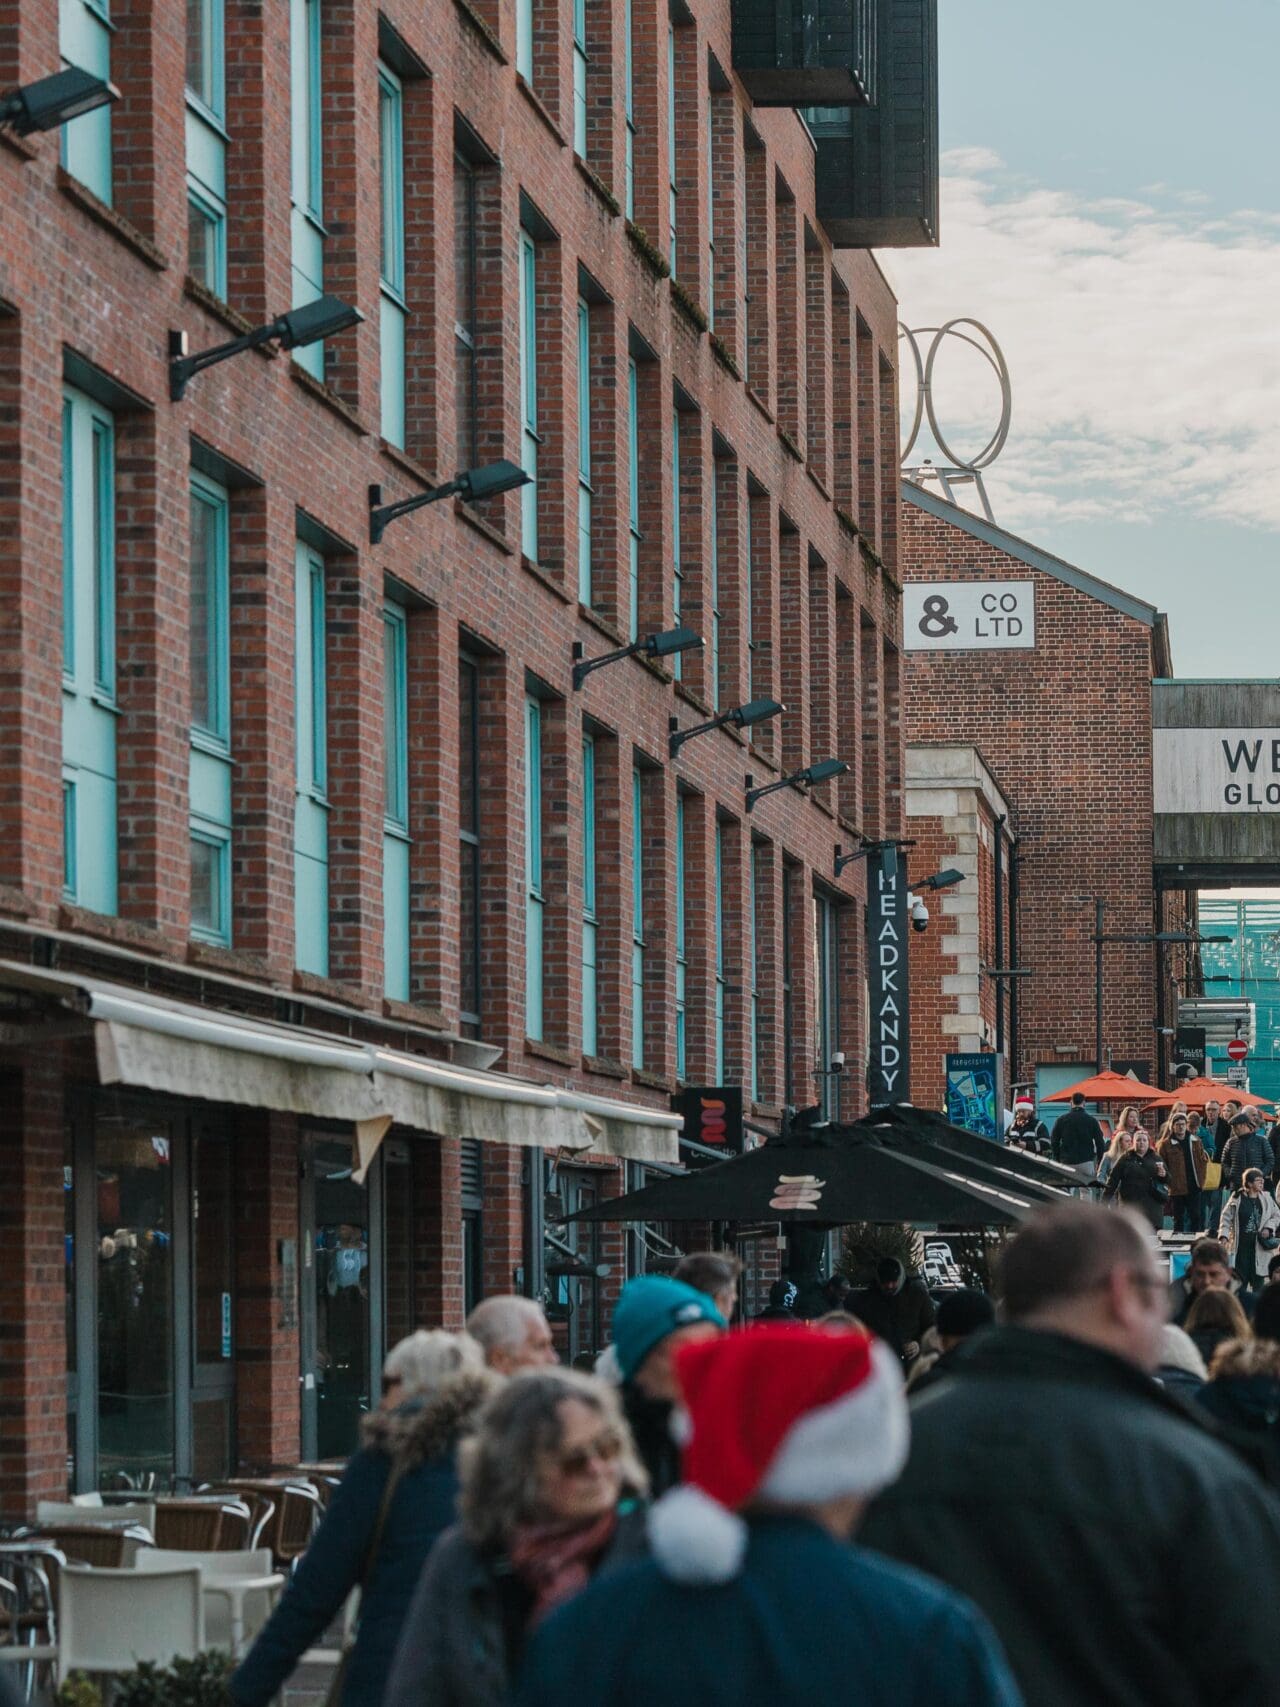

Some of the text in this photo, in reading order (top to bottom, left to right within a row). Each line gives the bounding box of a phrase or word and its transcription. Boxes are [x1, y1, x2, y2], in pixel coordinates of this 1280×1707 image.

[918, 595, 959, 638] &
[981, 593, 1017, 613] CO
[975, 617, 1022, 637] LTD
[878, 869, 900, 1092] HEADKANDY
